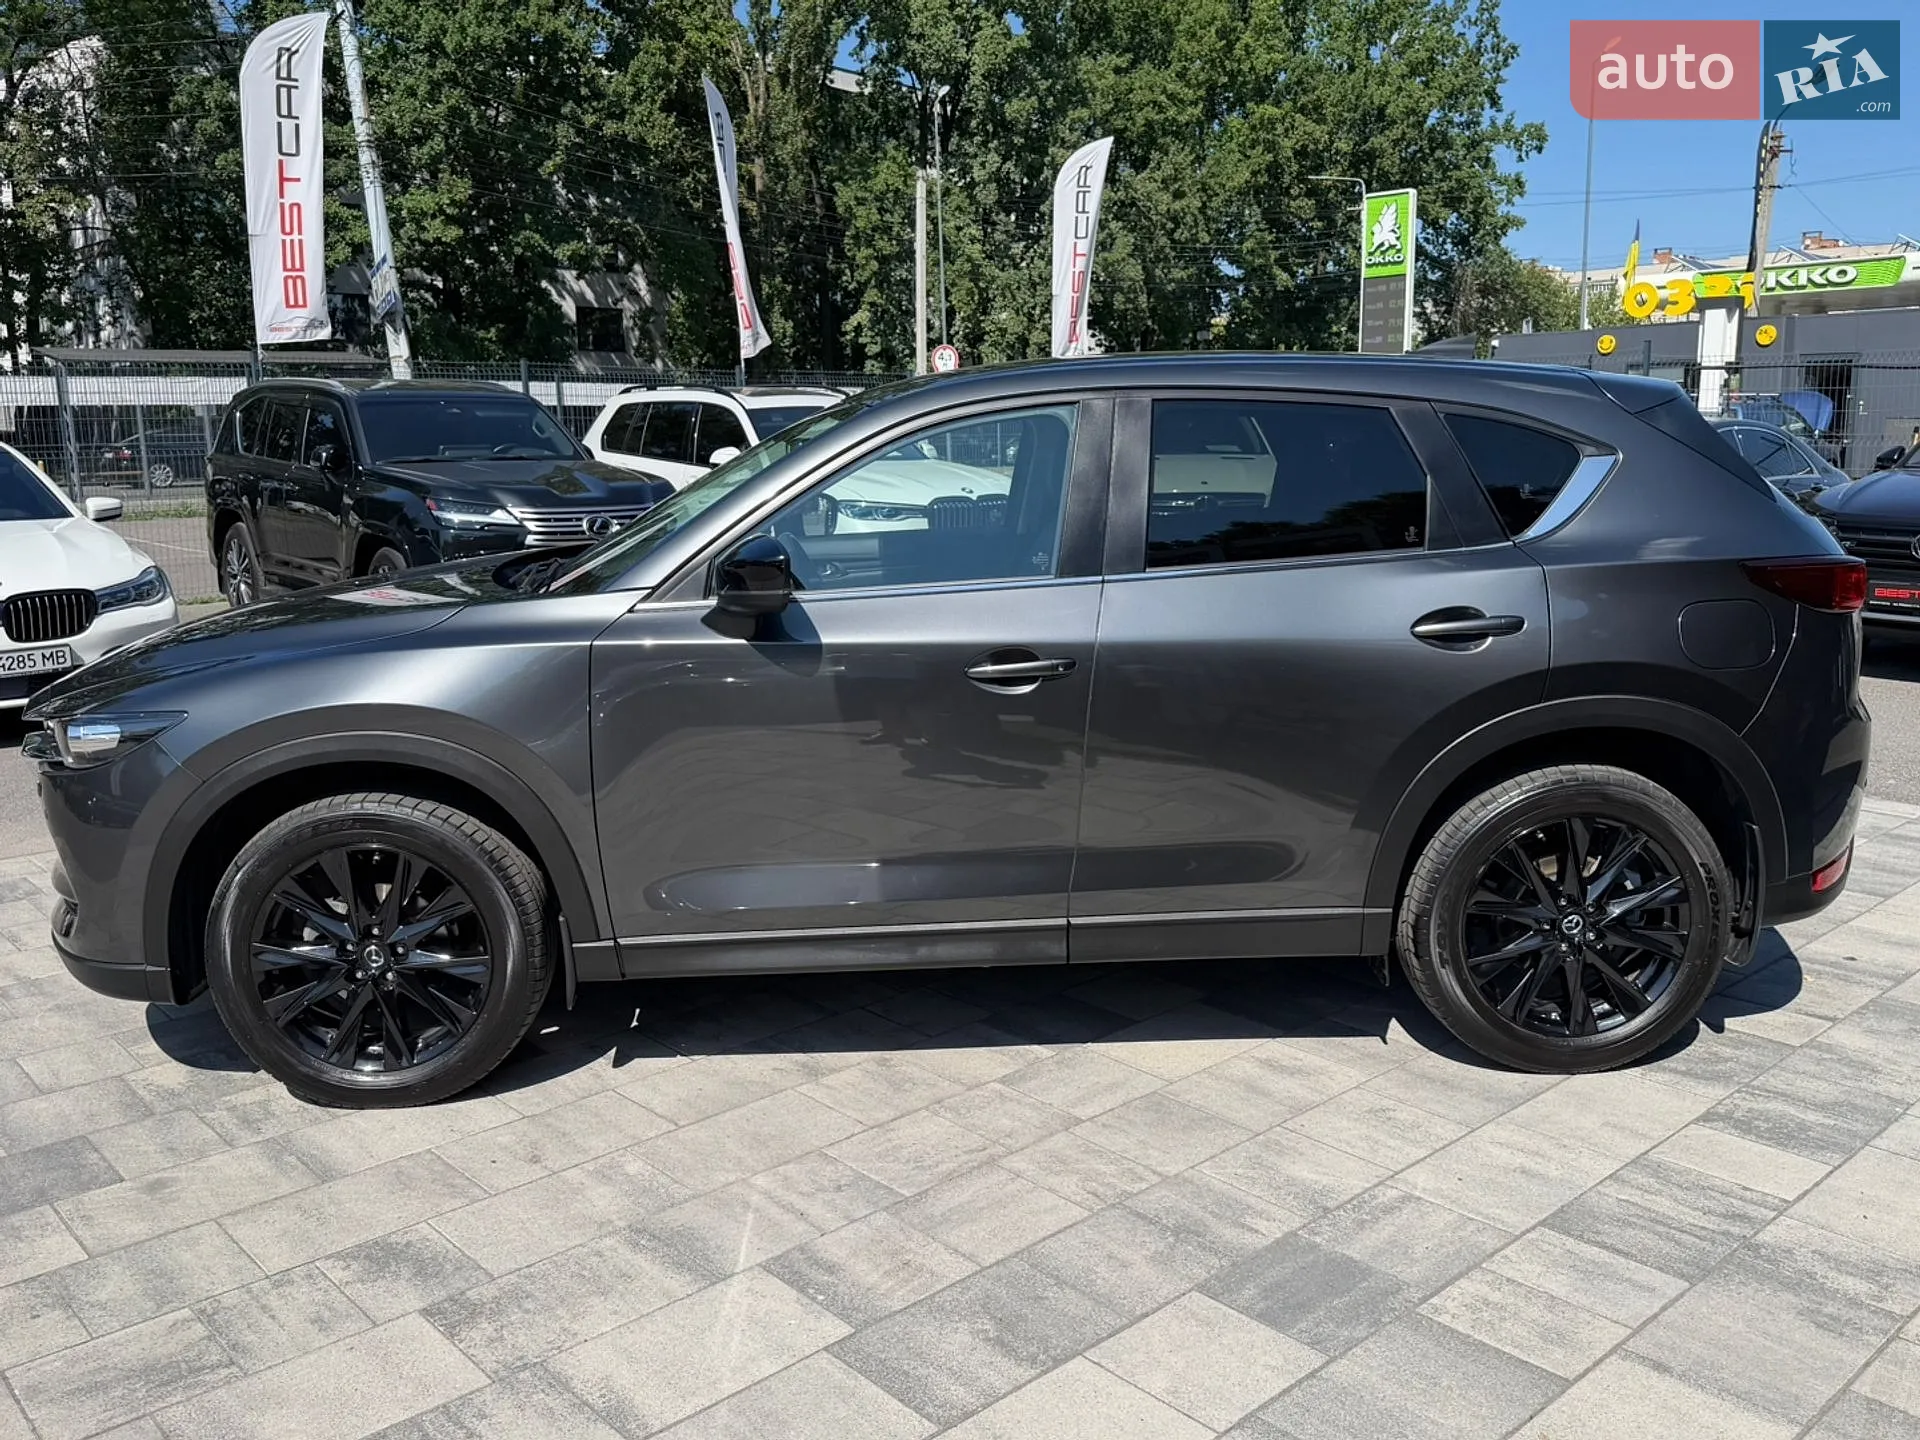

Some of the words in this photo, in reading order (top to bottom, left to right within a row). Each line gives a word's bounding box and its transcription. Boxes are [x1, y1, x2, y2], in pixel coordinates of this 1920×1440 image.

[1365, 253, 1404, 265] OKKO
[1740, 265, 1858, 289] KKO
[41, 649, 67, 668] MB
